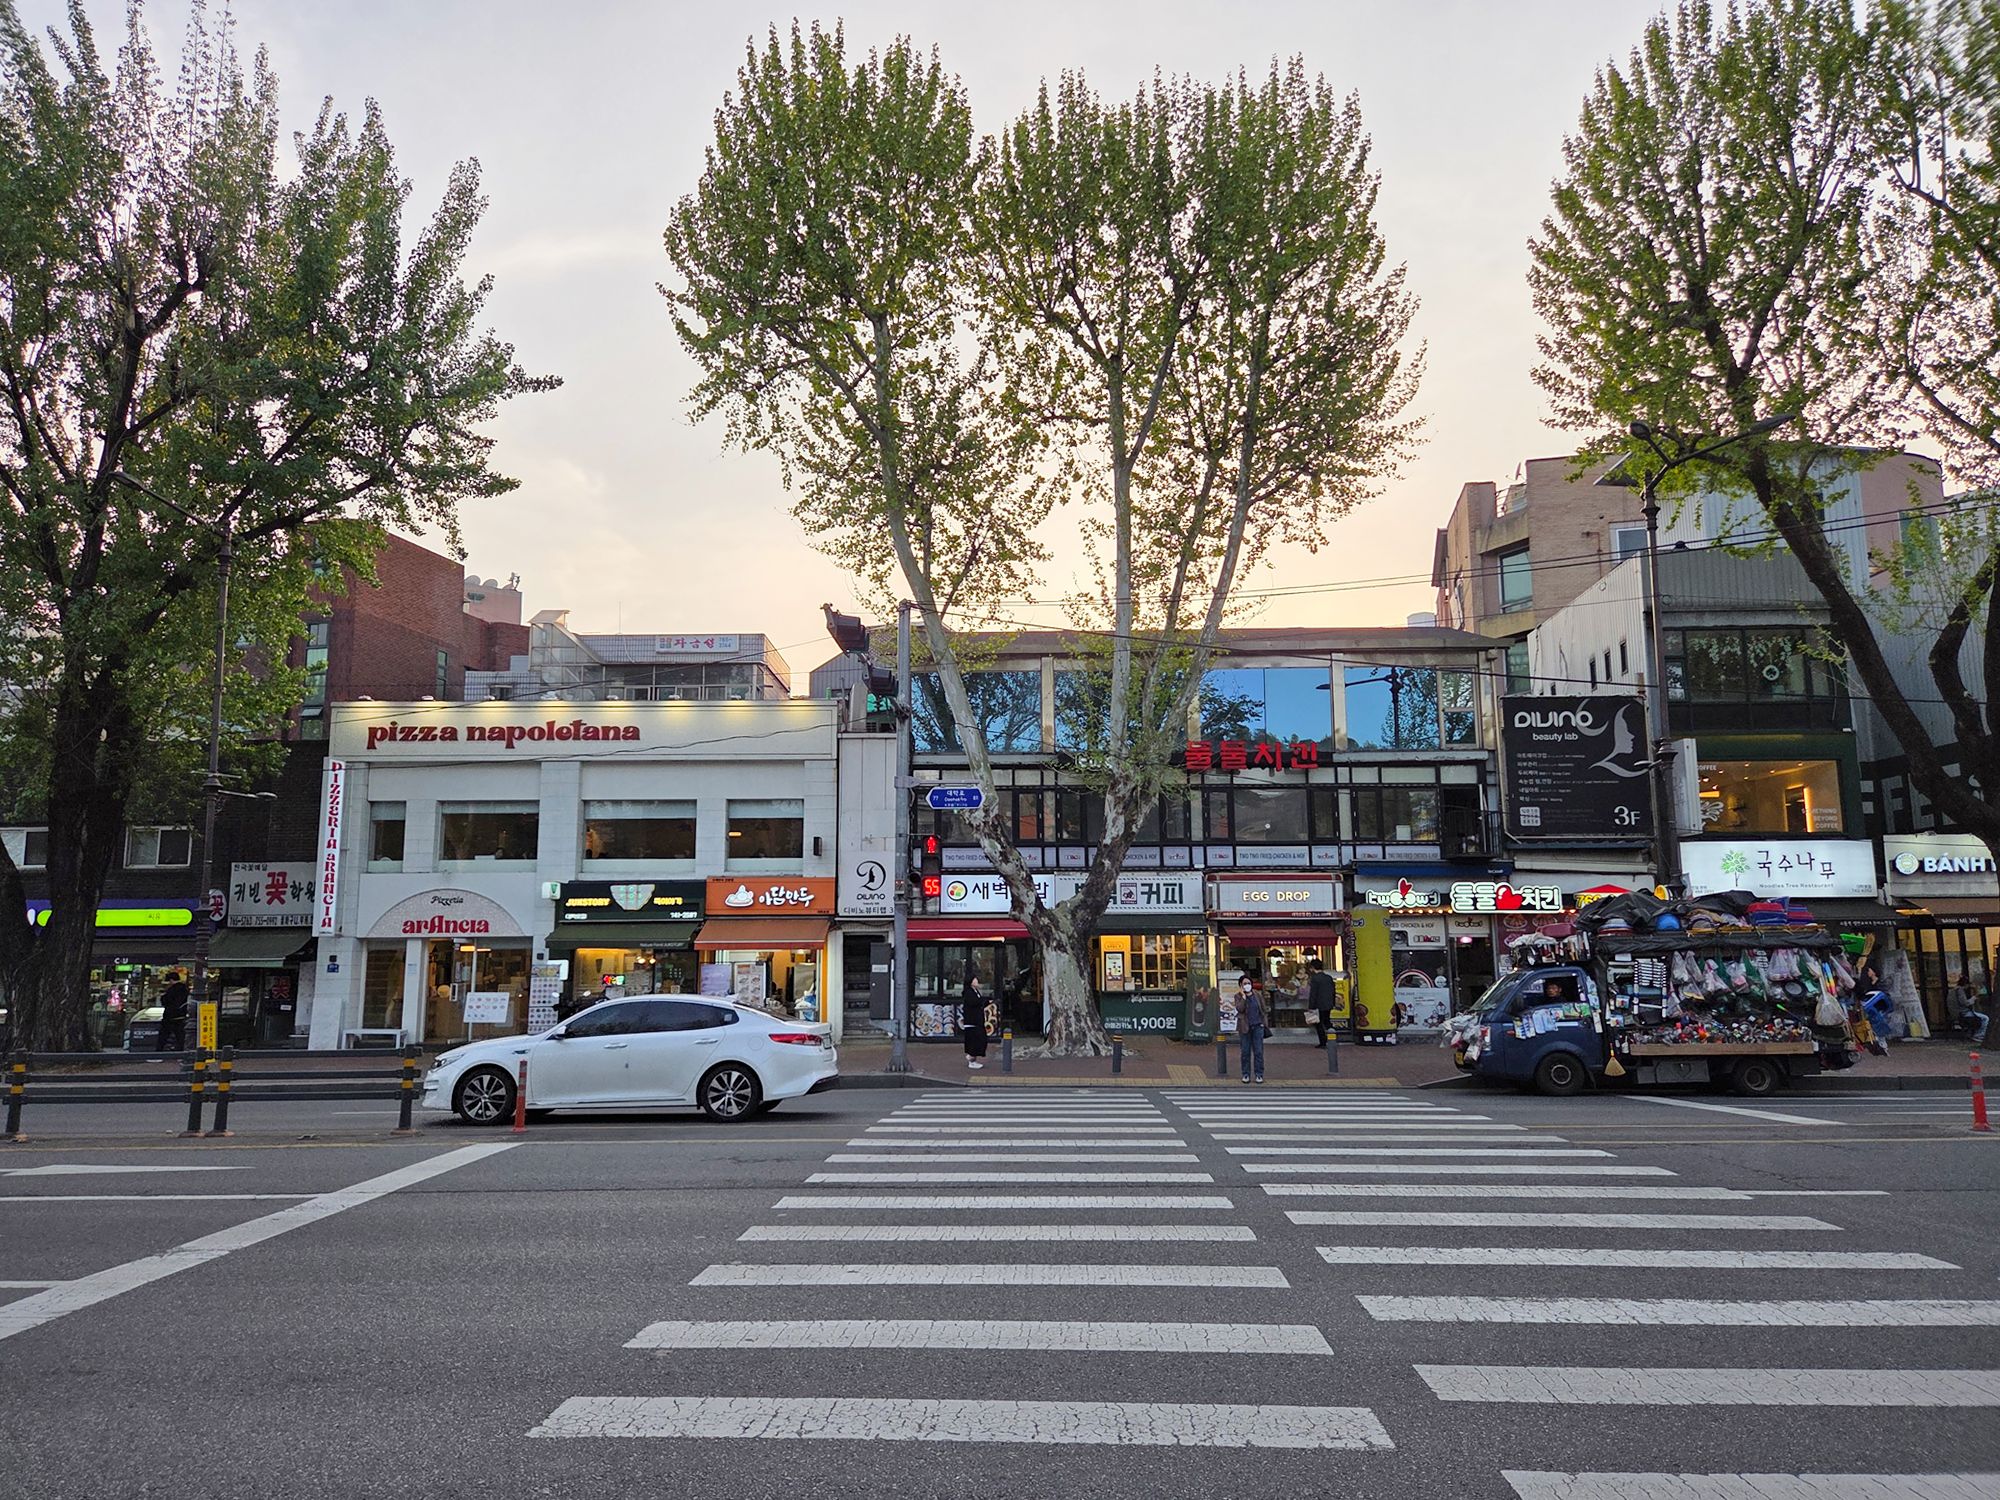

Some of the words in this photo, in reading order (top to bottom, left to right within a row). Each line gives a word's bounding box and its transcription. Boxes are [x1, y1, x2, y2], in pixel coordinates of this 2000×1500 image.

[674, 637, 715, 649] 자금성
[367, 721, 458, 749] pizza
[466, 720, 640, 749] napoletana
[1532, 733, 1562, 742] beauty
[1564, 732, 1578, 741] lab
[1185, 741, 1318, 771] 둘둘치킨
[327, 761, 344, 849] PIZZERIA
[1614, 806, 1641, 826] 3F
[1758, 850, 1835, 880] 국수나무
[1924, 853, 1985, 873] BÁNH
[265, 871, 288, 905] 꽃
[758, 885, 815, 908] 아담만두
[925, 879, 940, 895] 55
[1140, 883, 1183, 904] 커피
[1242, 891, 1270, 902] EGG
[1276, 891, 1310, 902] DROP
[211, 895, 225, 918] 꽃
[430, 895, 464, 907] Pizzeria
[1132, 1016, 1177, 1031] 1,900원
